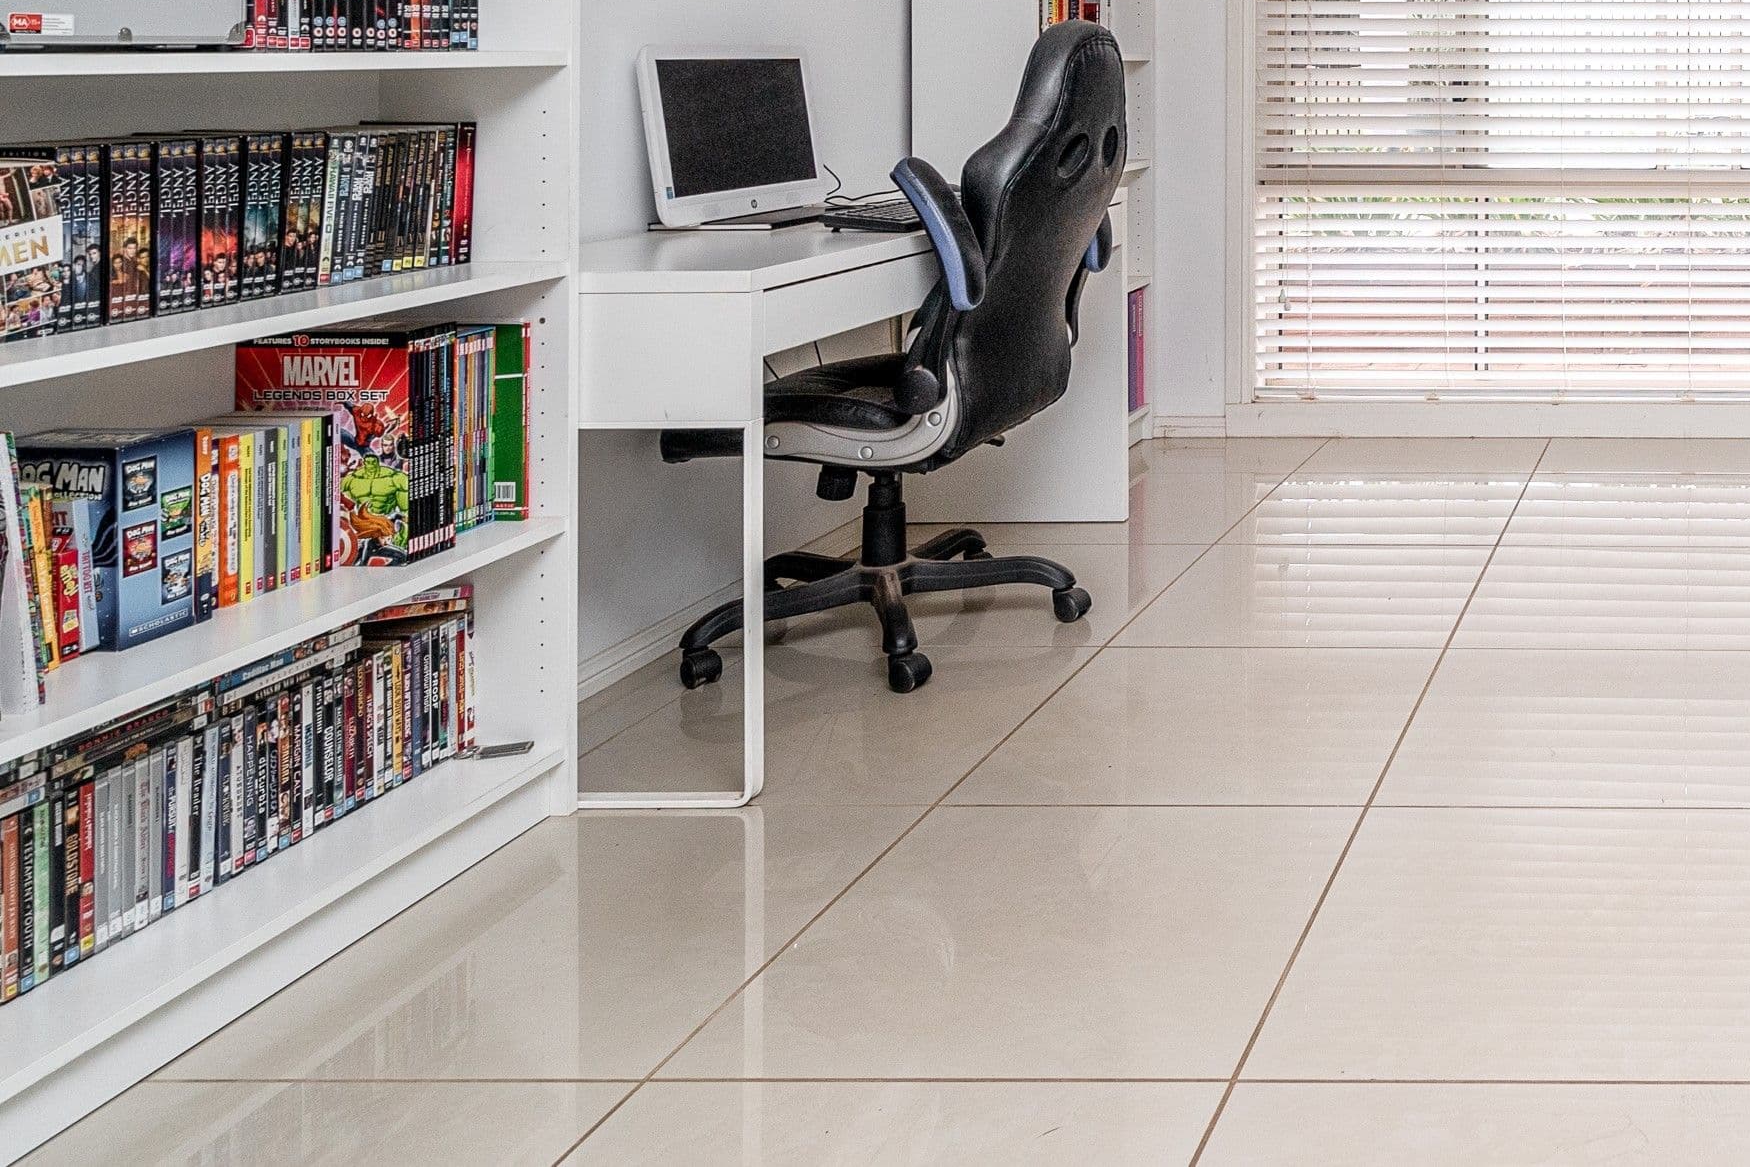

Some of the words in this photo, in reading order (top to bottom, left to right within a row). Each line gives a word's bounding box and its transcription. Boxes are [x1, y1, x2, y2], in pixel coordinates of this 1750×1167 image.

[173, 168, 184, 217] ANGEL
[186, 166, 196, 215] ANGEL
[204, 165, 214, 213] ANGEL
[216, 165, 227, 213] ANGEL
[229, 163, 239, 211] ANGEL
[293, 335, 309, 347] 10
[283, 355, 359, 386] MARVEL
[253, 390, 322, 401] LEGENDS
[326, 390, 356, 401] BOX
[359, 390, 389, 401] SET
[19, 461, 51, 483] OG
[55, 462, 104, 492] MAN
[200, 473, 210, 496] DOG
[200, 497, 209, 515] MAN
[82, 551, 92, 581] TATTOO
[138, 611, 187, 631] SCHOLASTIC
[193, 756, 202, 775] The
[192, 778, 202, 817] Reader
[23, 841, 33, 902] TESTAMENT
[65, 834, 78, 895] GOLDSTONE
[23, 911, 32, 949] YOUTH
